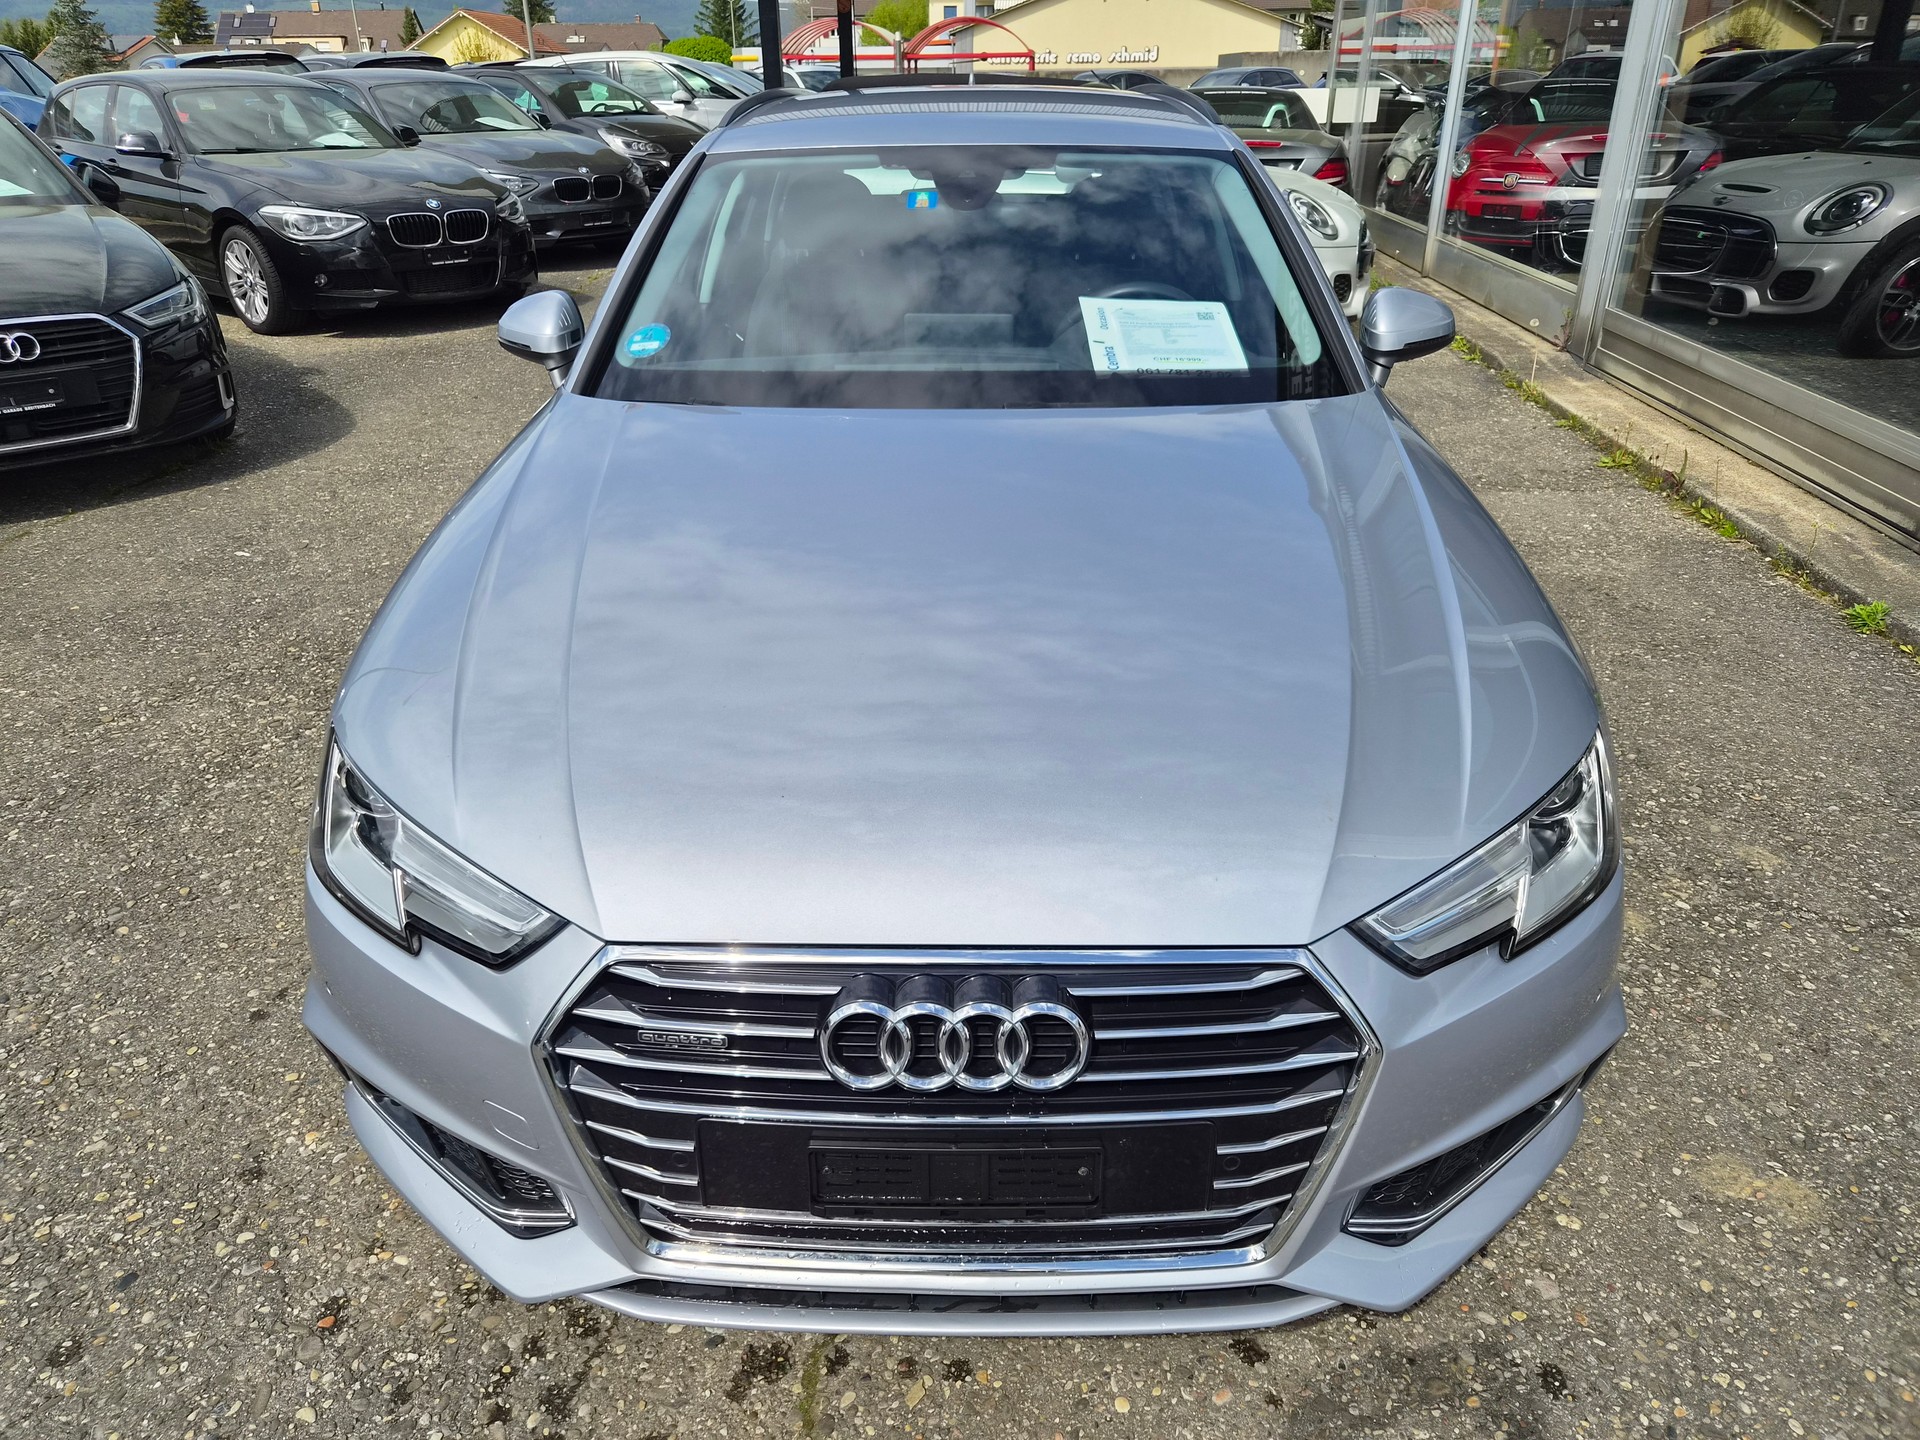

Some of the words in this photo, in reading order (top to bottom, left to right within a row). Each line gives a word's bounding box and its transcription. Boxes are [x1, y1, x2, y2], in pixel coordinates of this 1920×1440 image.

[1066, 52, 1102, 64] remo
[1107, 45, 1159, 64] schmid
[1097, 307, 1109, 330] Occasion
[1104, 346, 1120, 370] Cembra
[641, 1033, 723, 1045] quattro
